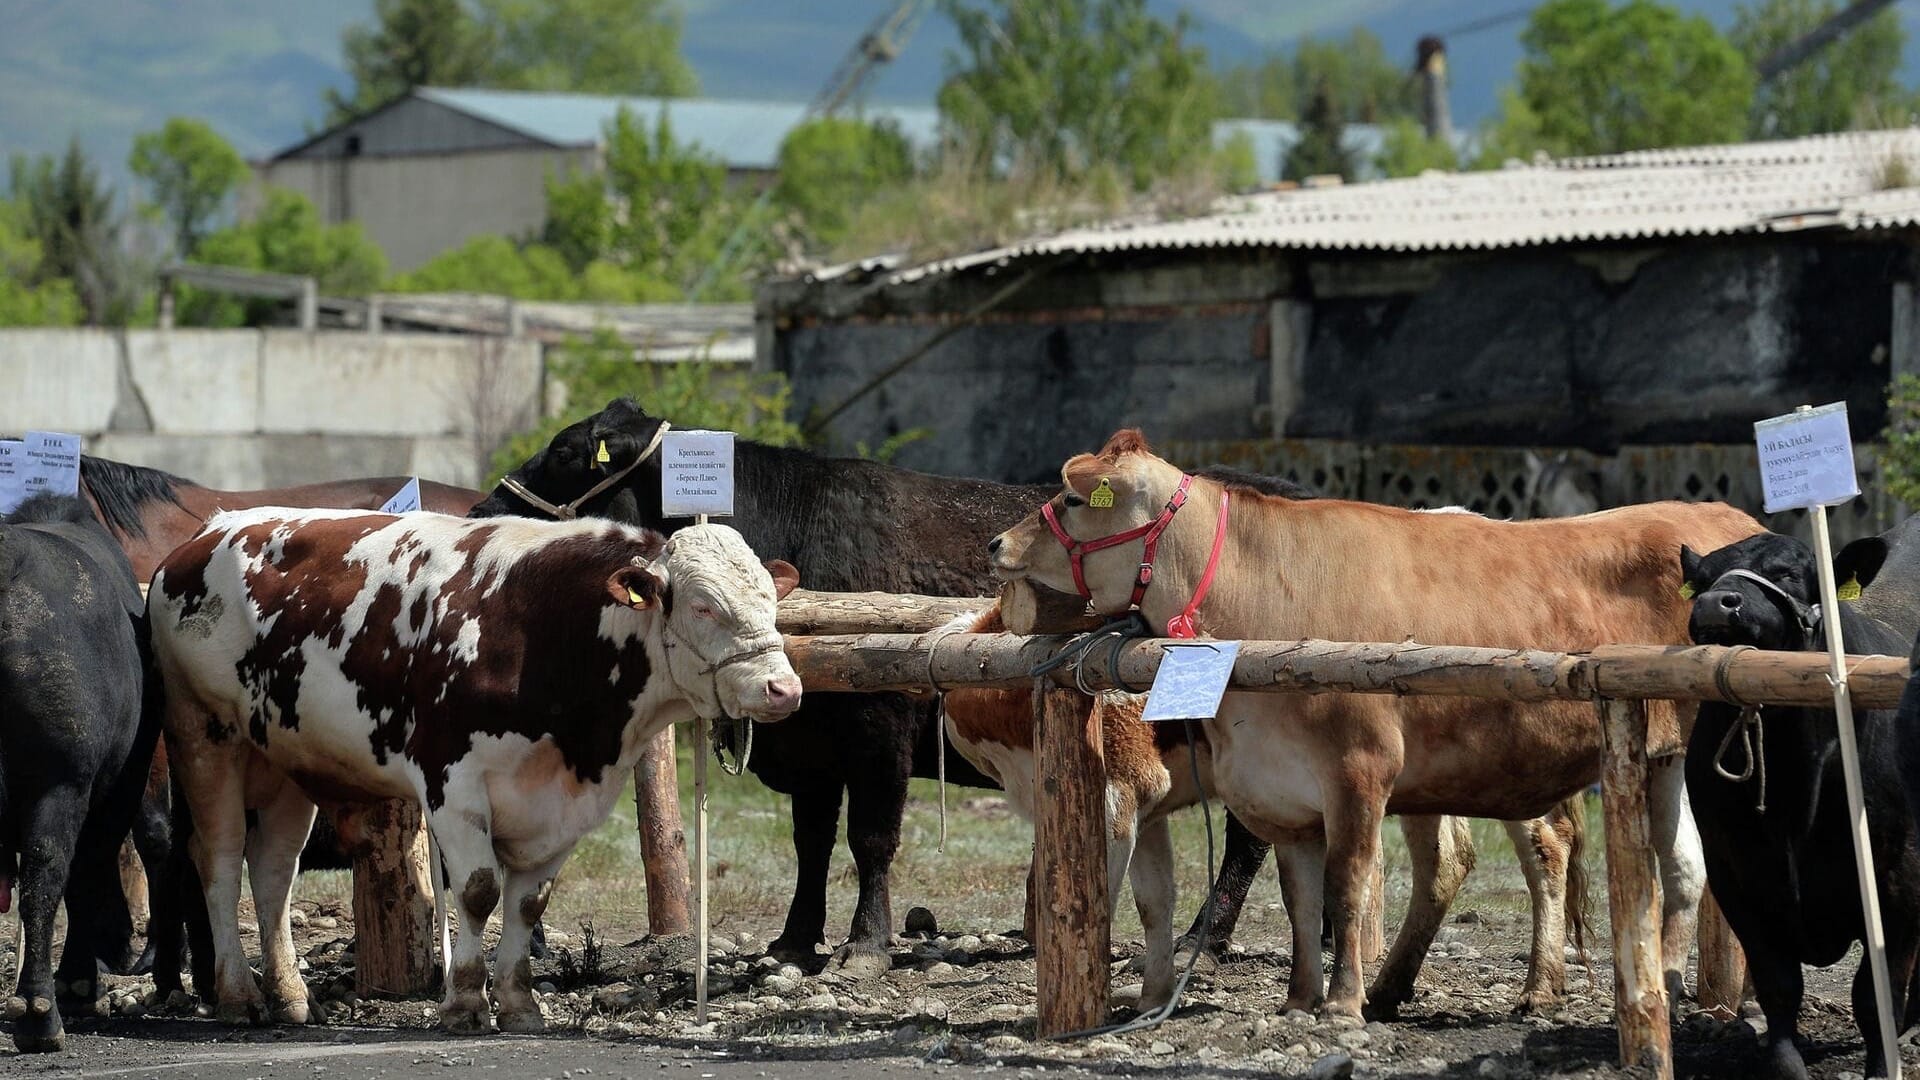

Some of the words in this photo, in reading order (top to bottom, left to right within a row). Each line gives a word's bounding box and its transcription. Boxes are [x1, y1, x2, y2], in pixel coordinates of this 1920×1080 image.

[1777, 434, 1813, 450] БАЛАСЫ
[678, 448, 715, 458] Крестьянское
[699, 461, 726, 469] хозяйство
